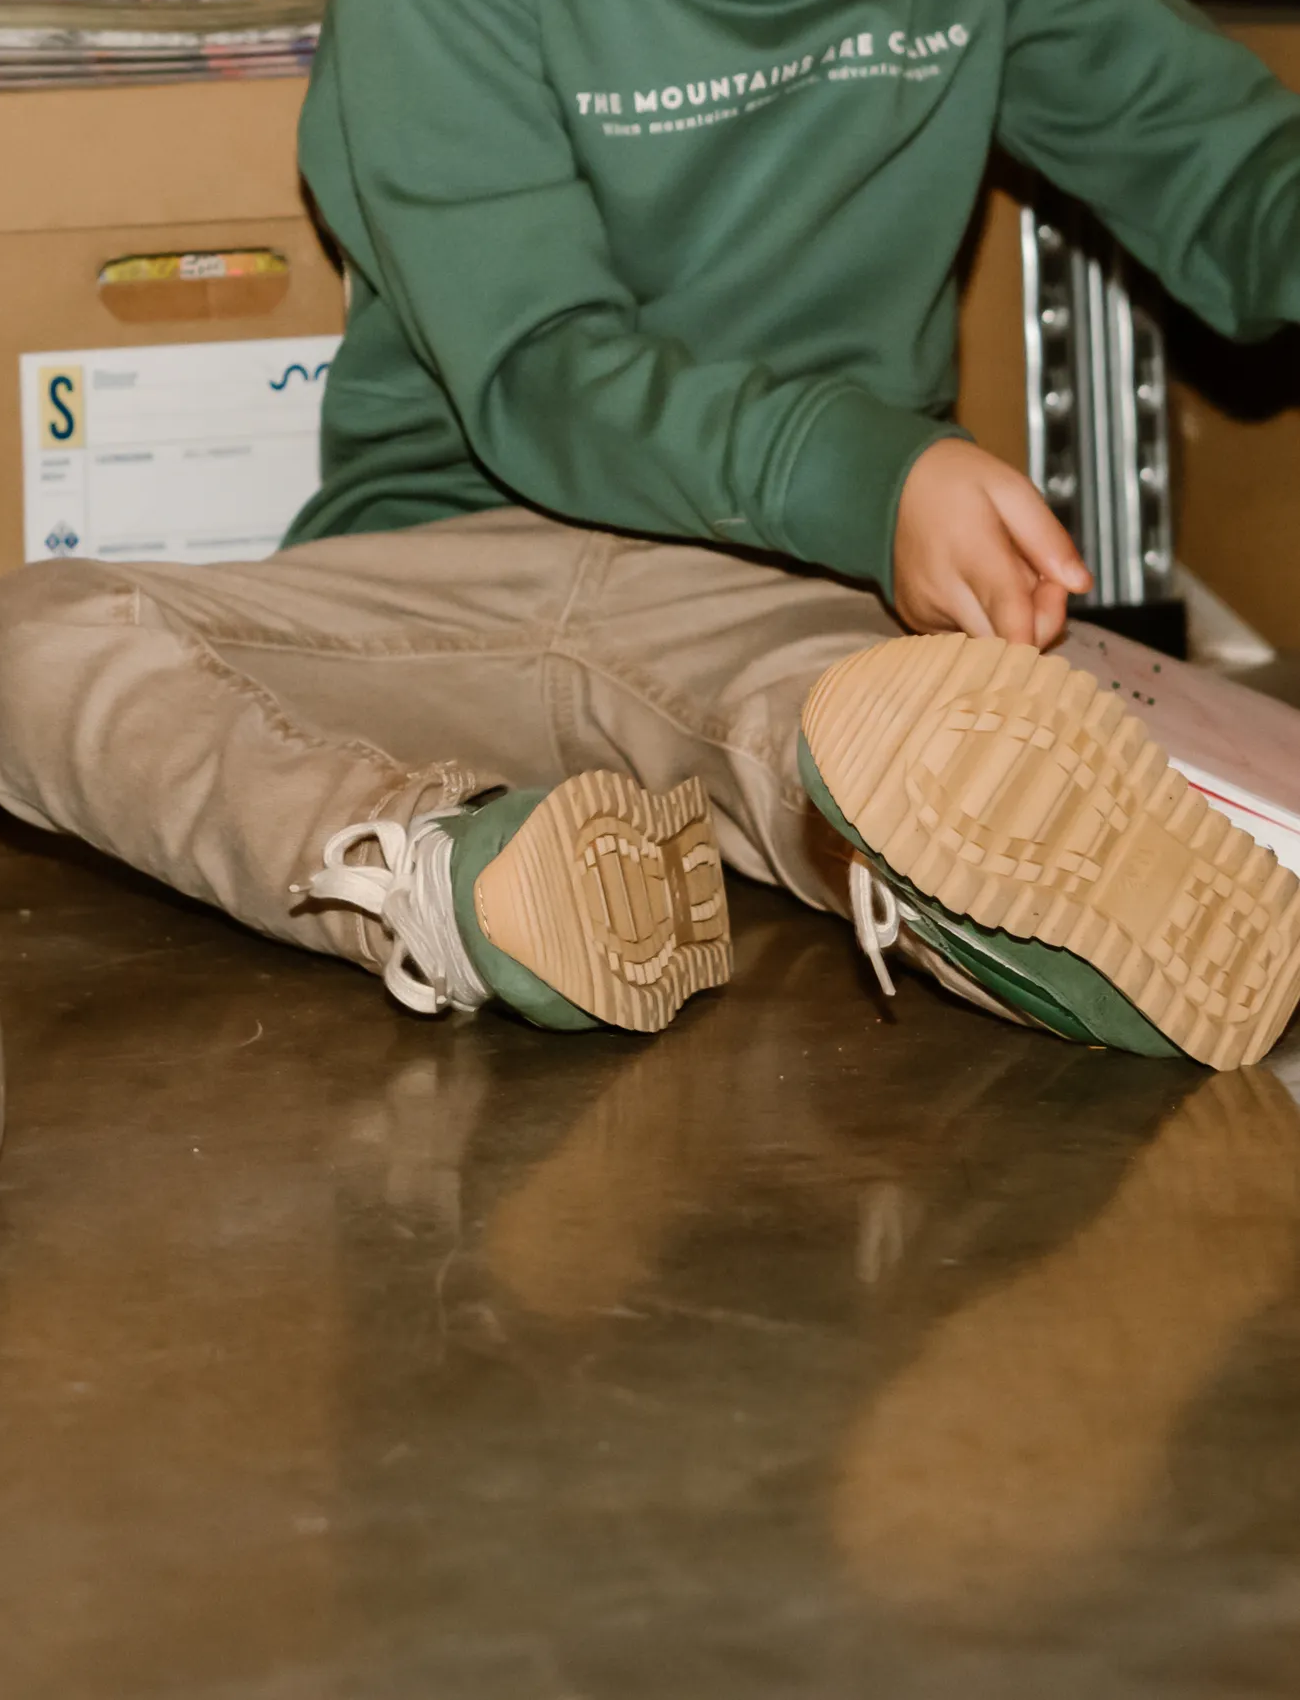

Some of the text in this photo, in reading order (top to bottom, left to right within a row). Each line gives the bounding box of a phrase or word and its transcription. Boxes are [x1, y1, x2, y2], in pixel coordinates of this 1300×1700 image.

[575, 90, 622, 116] THE
[633, 54, 814, 115] MOUNTAINS
[820, 32, 874, 66] ARE
[48, 374, 75, 441] S
